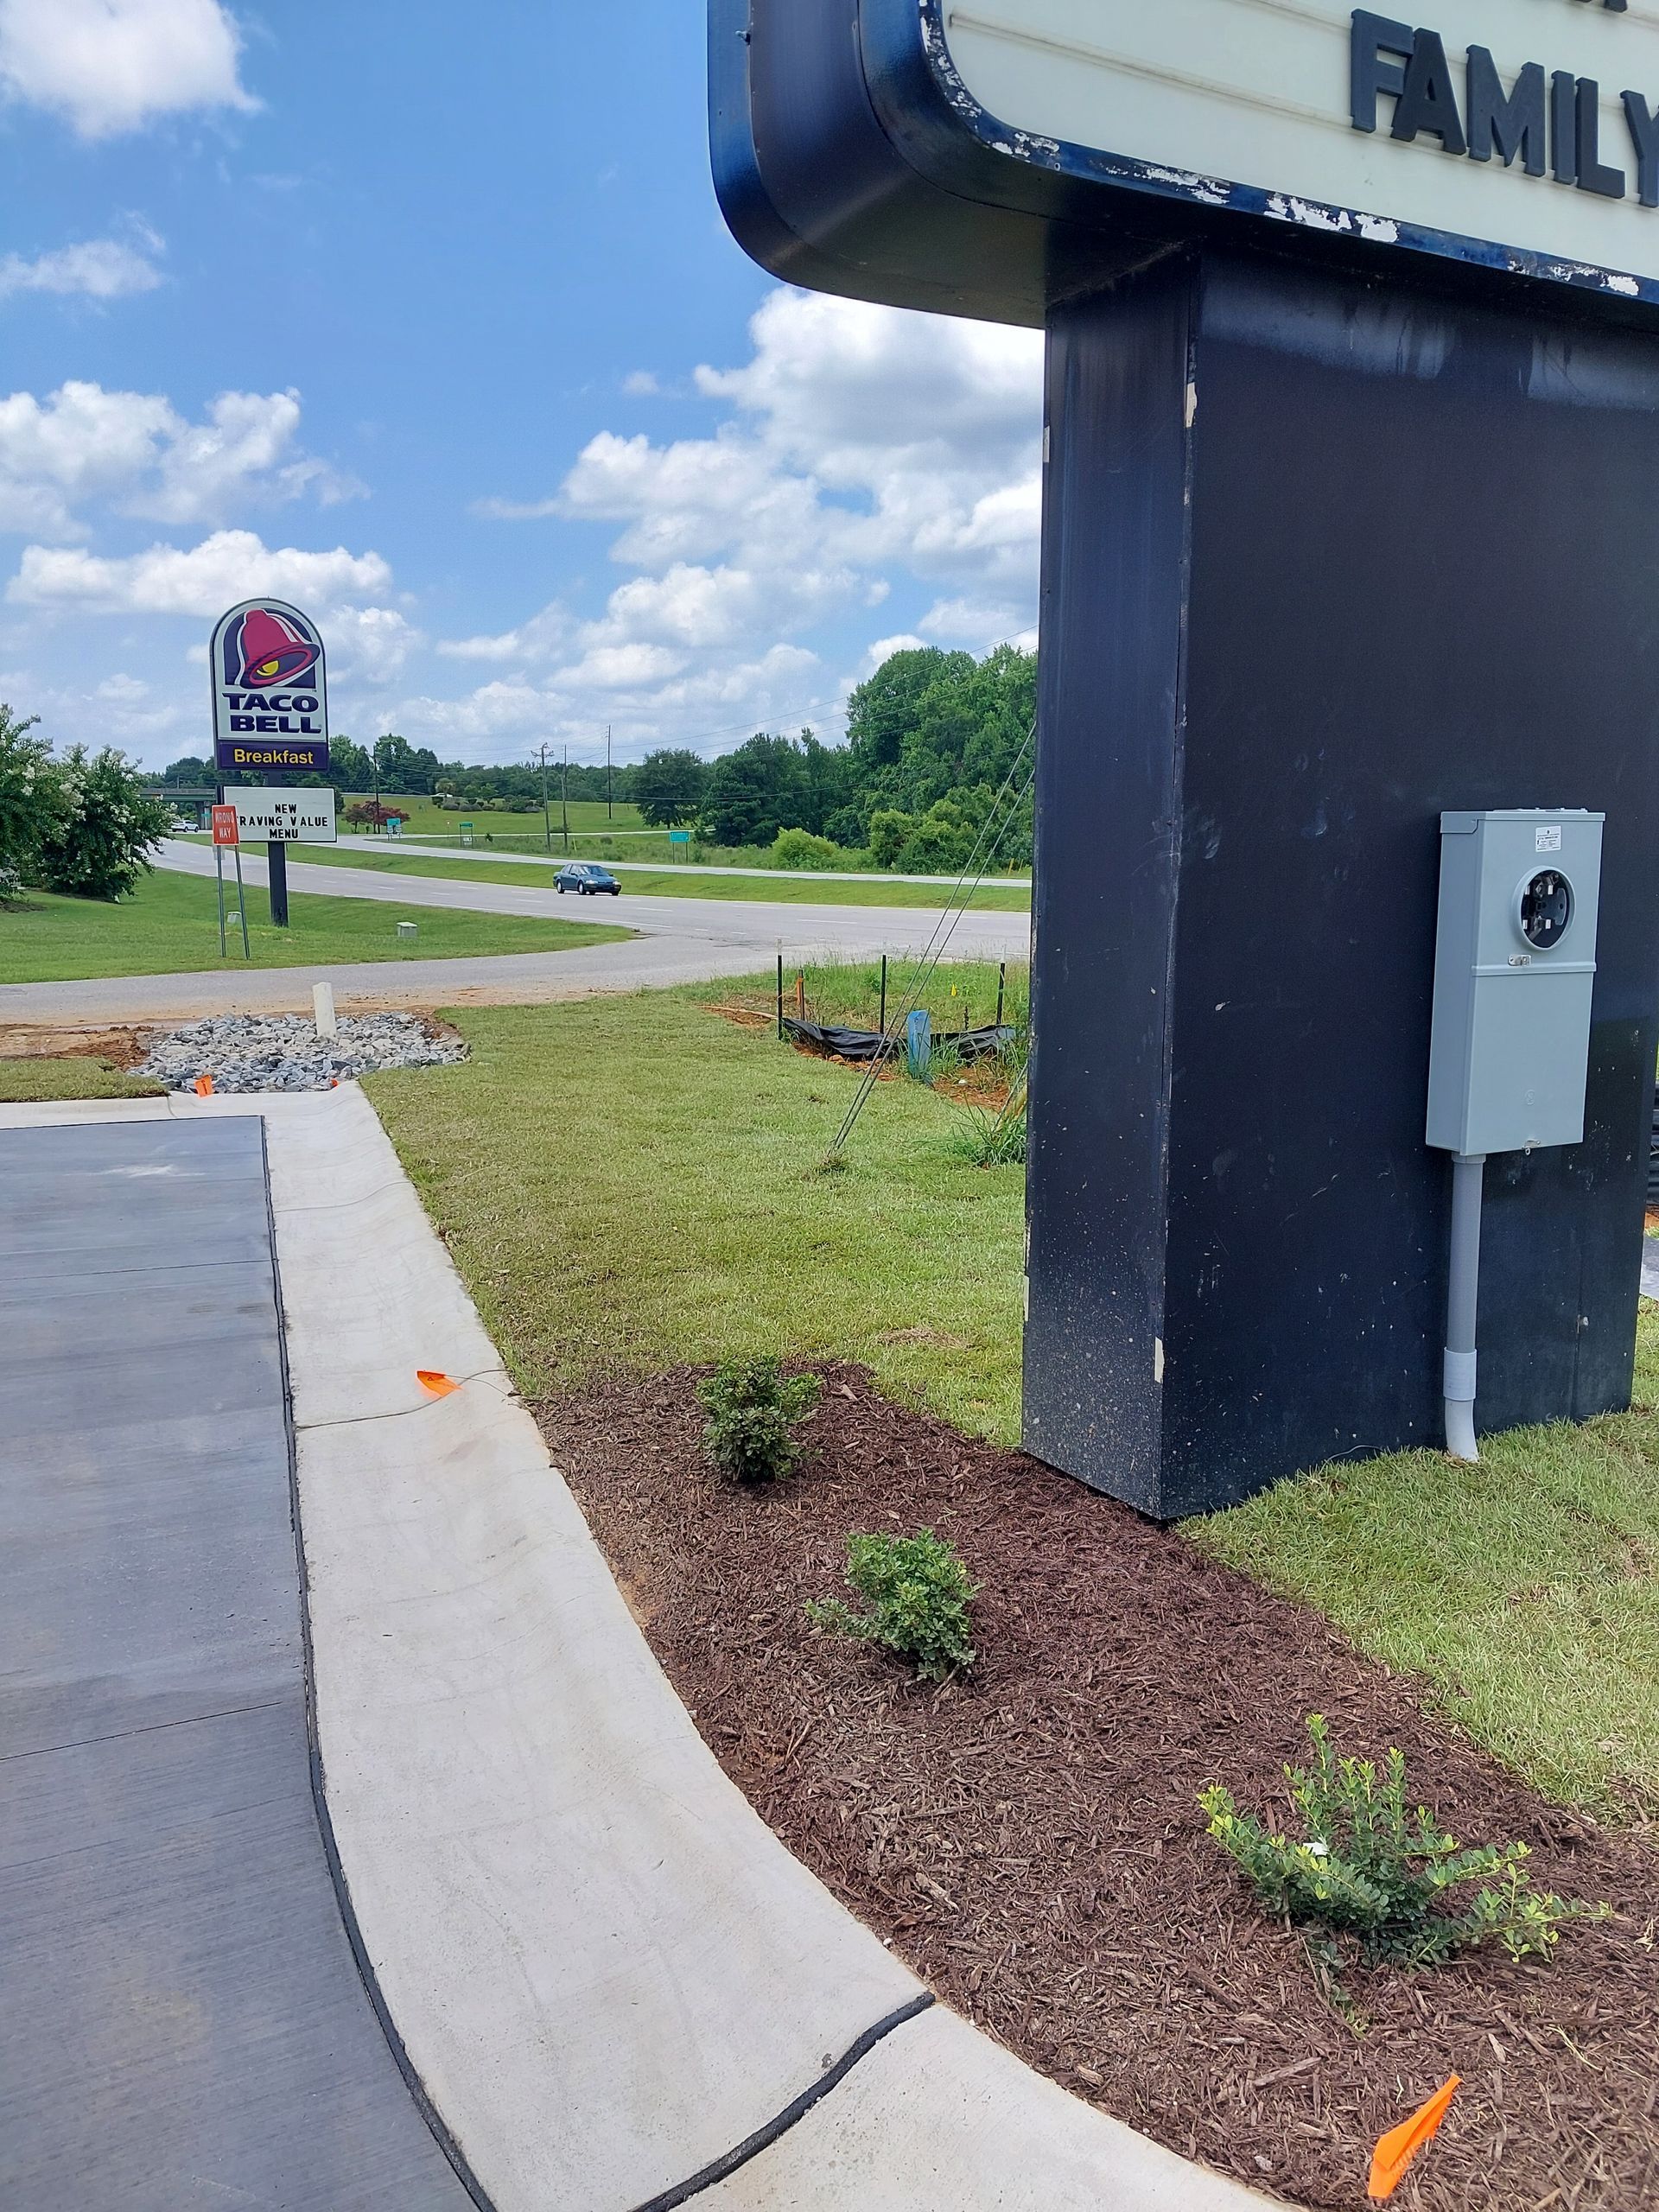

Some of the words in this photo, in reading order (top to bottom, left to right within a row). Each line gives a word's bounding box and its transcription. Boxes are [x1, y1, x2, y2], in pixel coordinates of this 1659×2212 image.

[1351, 8, 1659, 208] FAMILY
[222, 693, 319, 713] TACO
[230, 715, 322, 734] BELL
[234, 748, 314, 765] Breakfast
[275, 804, 296, 814] NEW
[215, 811, 234, 823] WRONG
[236, 816, 283, 826] RAVING
[290, 817, 328, 827] VALUE
[219, 827, 232, 838] WAY
[269, 829, 298, 839] MENU
